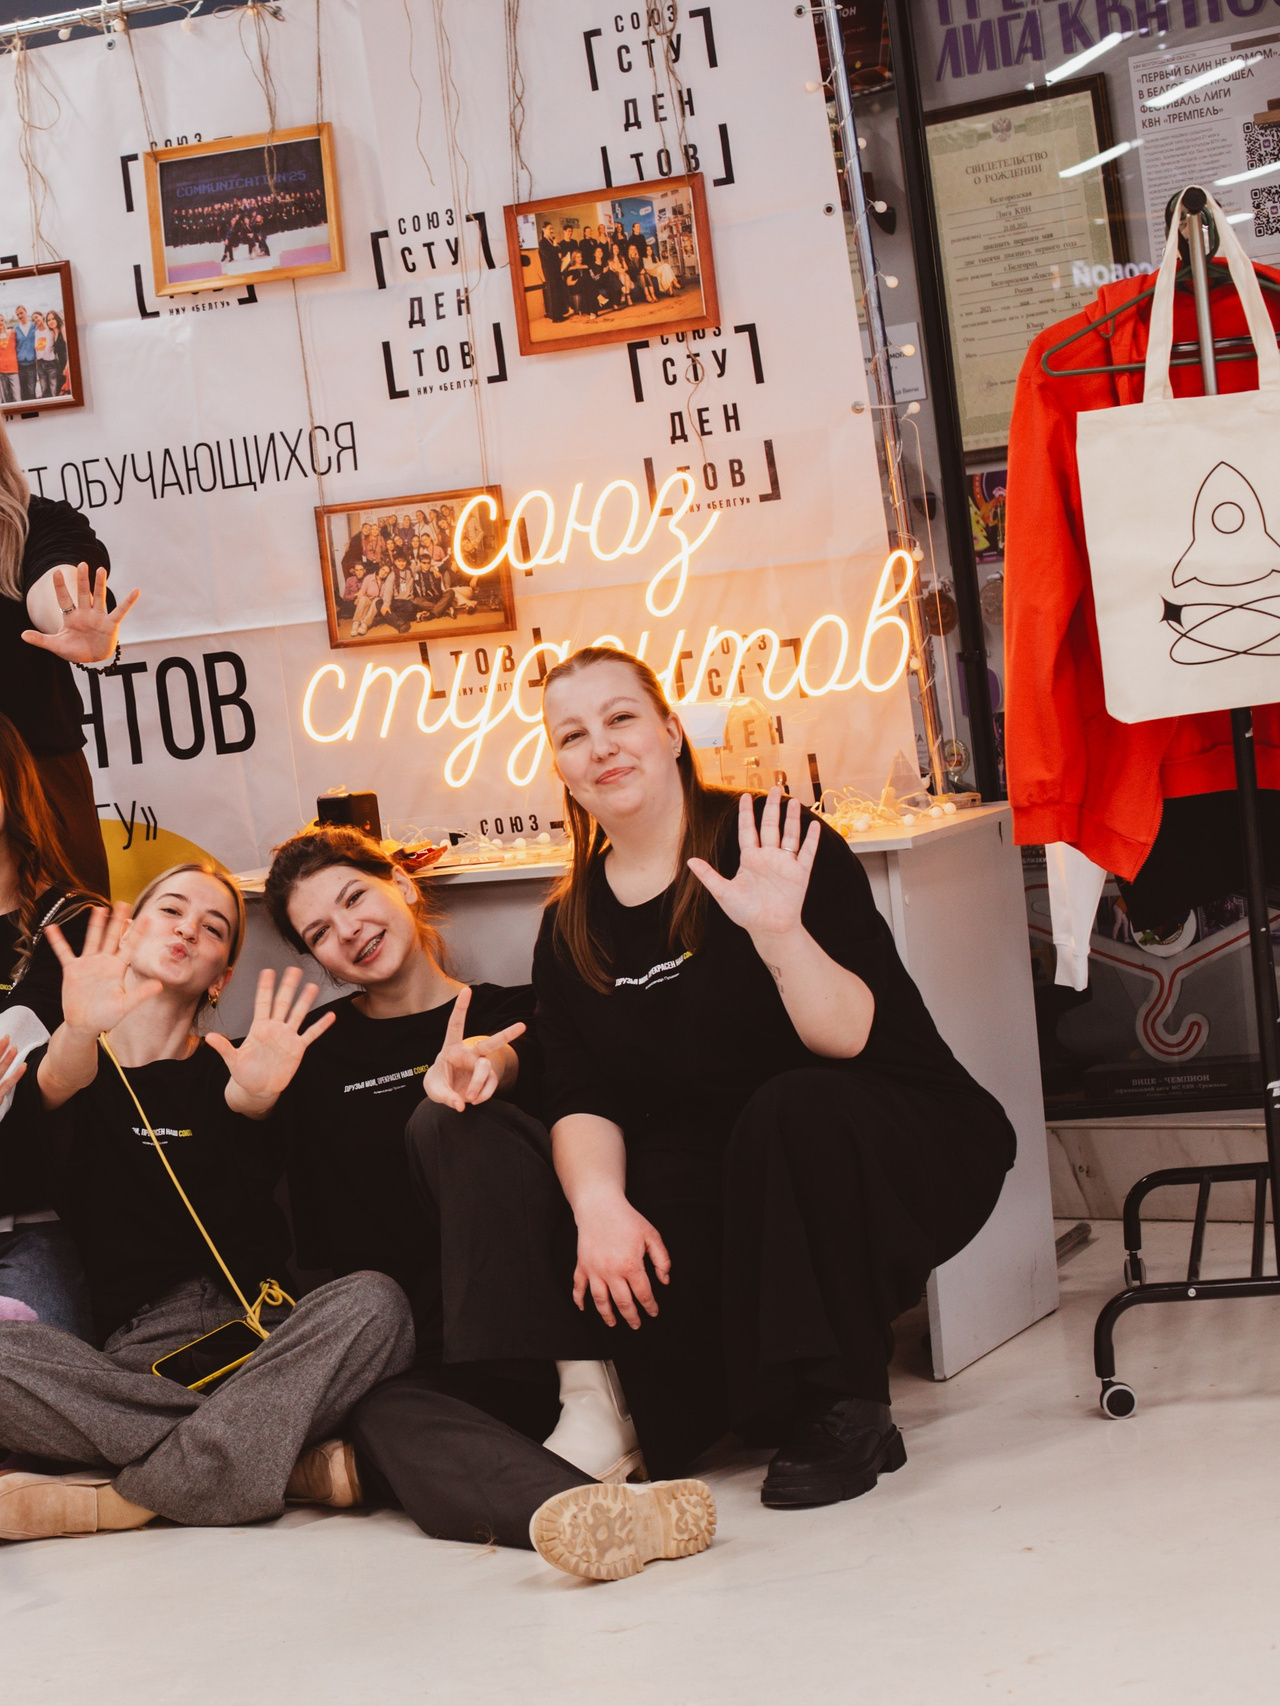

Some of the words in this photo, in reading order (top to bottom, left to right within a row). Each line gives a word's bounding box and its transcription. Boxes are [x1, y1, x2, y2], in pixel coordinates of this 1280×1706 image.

[614, 4, 678, 33] СОЮЗ
[617, 33, 682, 74] СТУ
[936, 9, 1045, 82] ЛИГА
[1184, 61, 1212, 76] БЛИН
[623, 87, 695, 132] ДЕН
[1203, 88, 1231, 102] ЛИГИ
[1141, 117, 1161, 129] КВН
[630, 143, 700, 182] ТОВ
[965, 151, 1048, 175] СВИДЕТЕЛЬСТВО
[985, 164, 1042, 184] РОЖДЕНИИ
[398, 208, 455, 235] СОЮЗ
[400, 237, 461, 273] СТУ
[408, 287, 470, 329] ДЕН
[413, 341, 475, 377] ТОВ
[662, 348, 727, 386] СТУ
[670, 403, 741, 445] ДЕН
[60, 421, 360, 511] ОБУЧАЮЩИХСЯ
[453, 470, 724, 618] союз
[301, 548, 917, 789] студнтов
[480, 813, 539, 837] СОЮЗ
[1165, 1074, 1210, 1084] ЧЕМПИОН
